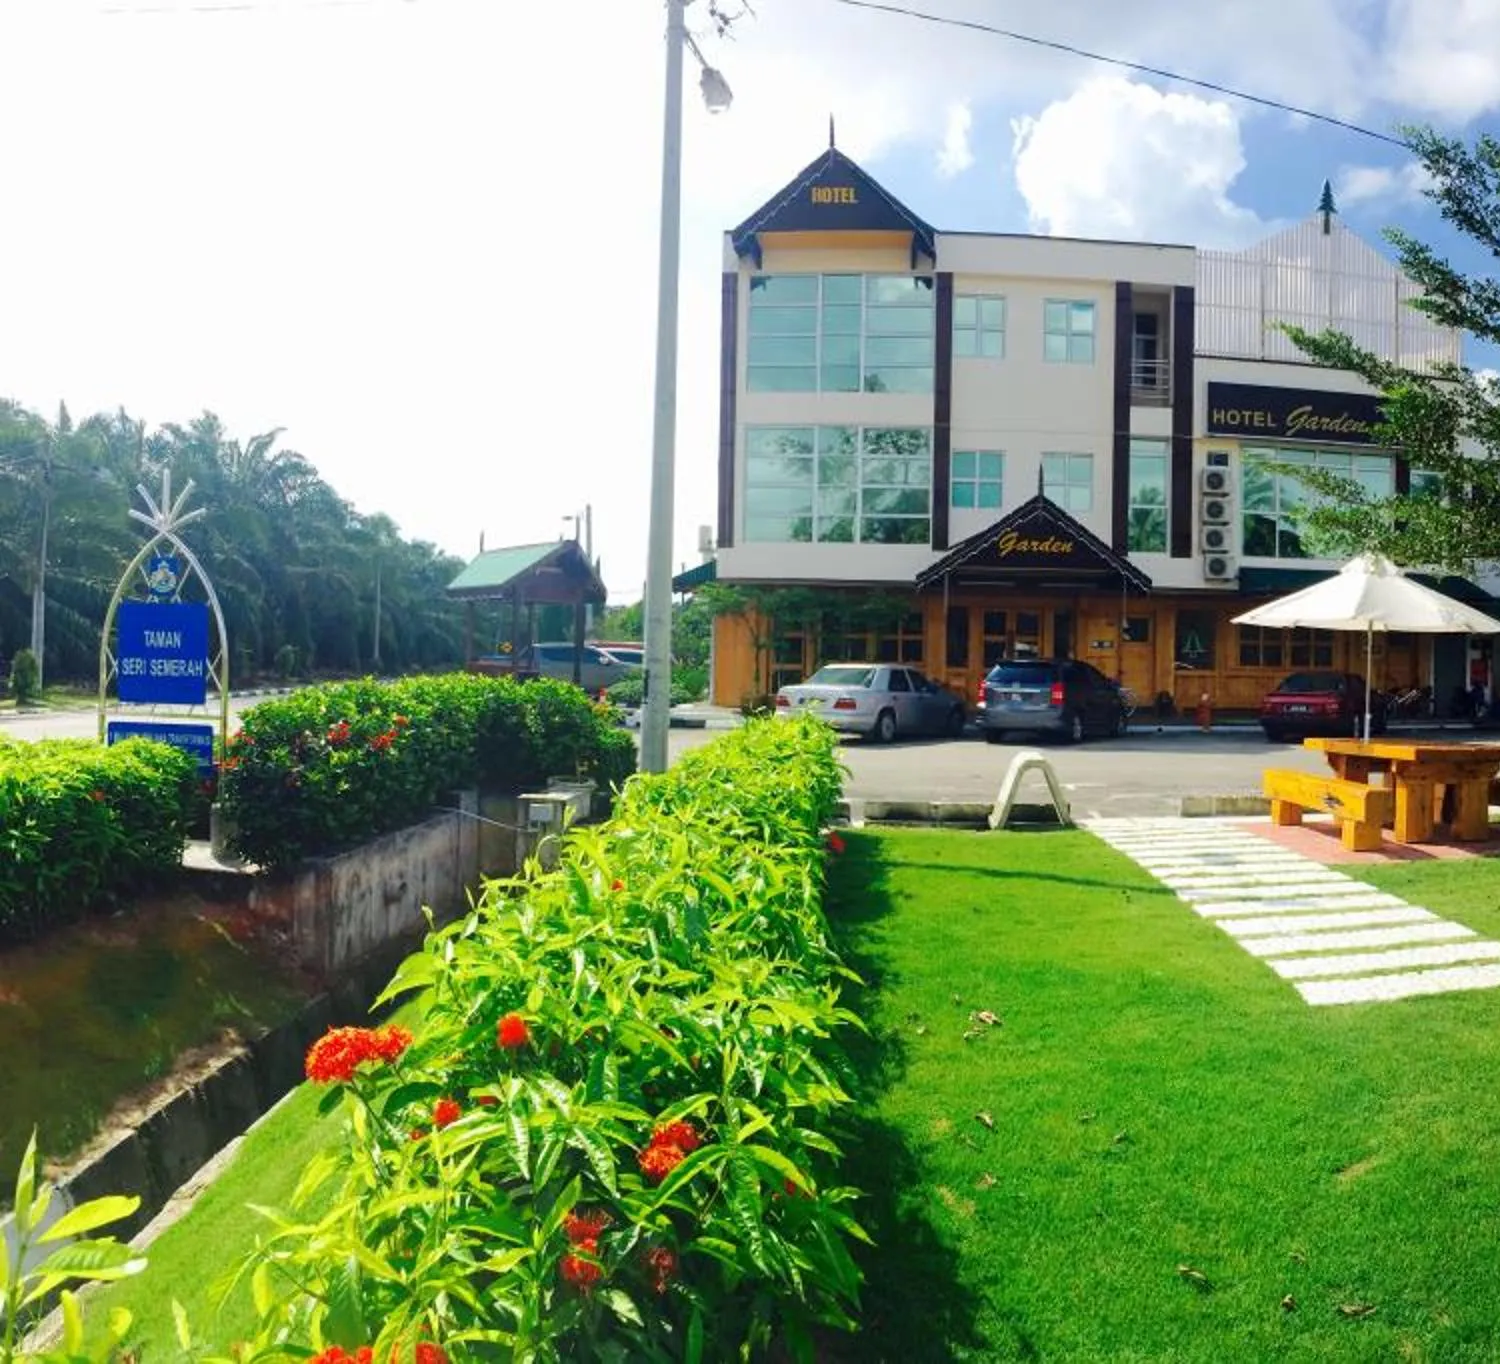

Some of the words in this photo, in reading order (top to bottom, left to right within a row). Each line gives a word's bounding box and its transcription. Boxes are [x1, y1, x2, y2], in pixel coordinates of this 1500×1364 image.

[811, 187, 859, 204] HOTEL
[1213, 409, 1276, 427] HOTEL
[1285, 405, 1368, 437] Garden
[999, 532, 1073, 556] Garden
[144, 630, 182, 649] TAMAN
[122, 658, 147, 676] SERI
[150, 659, 203, 677] SEMERAH
